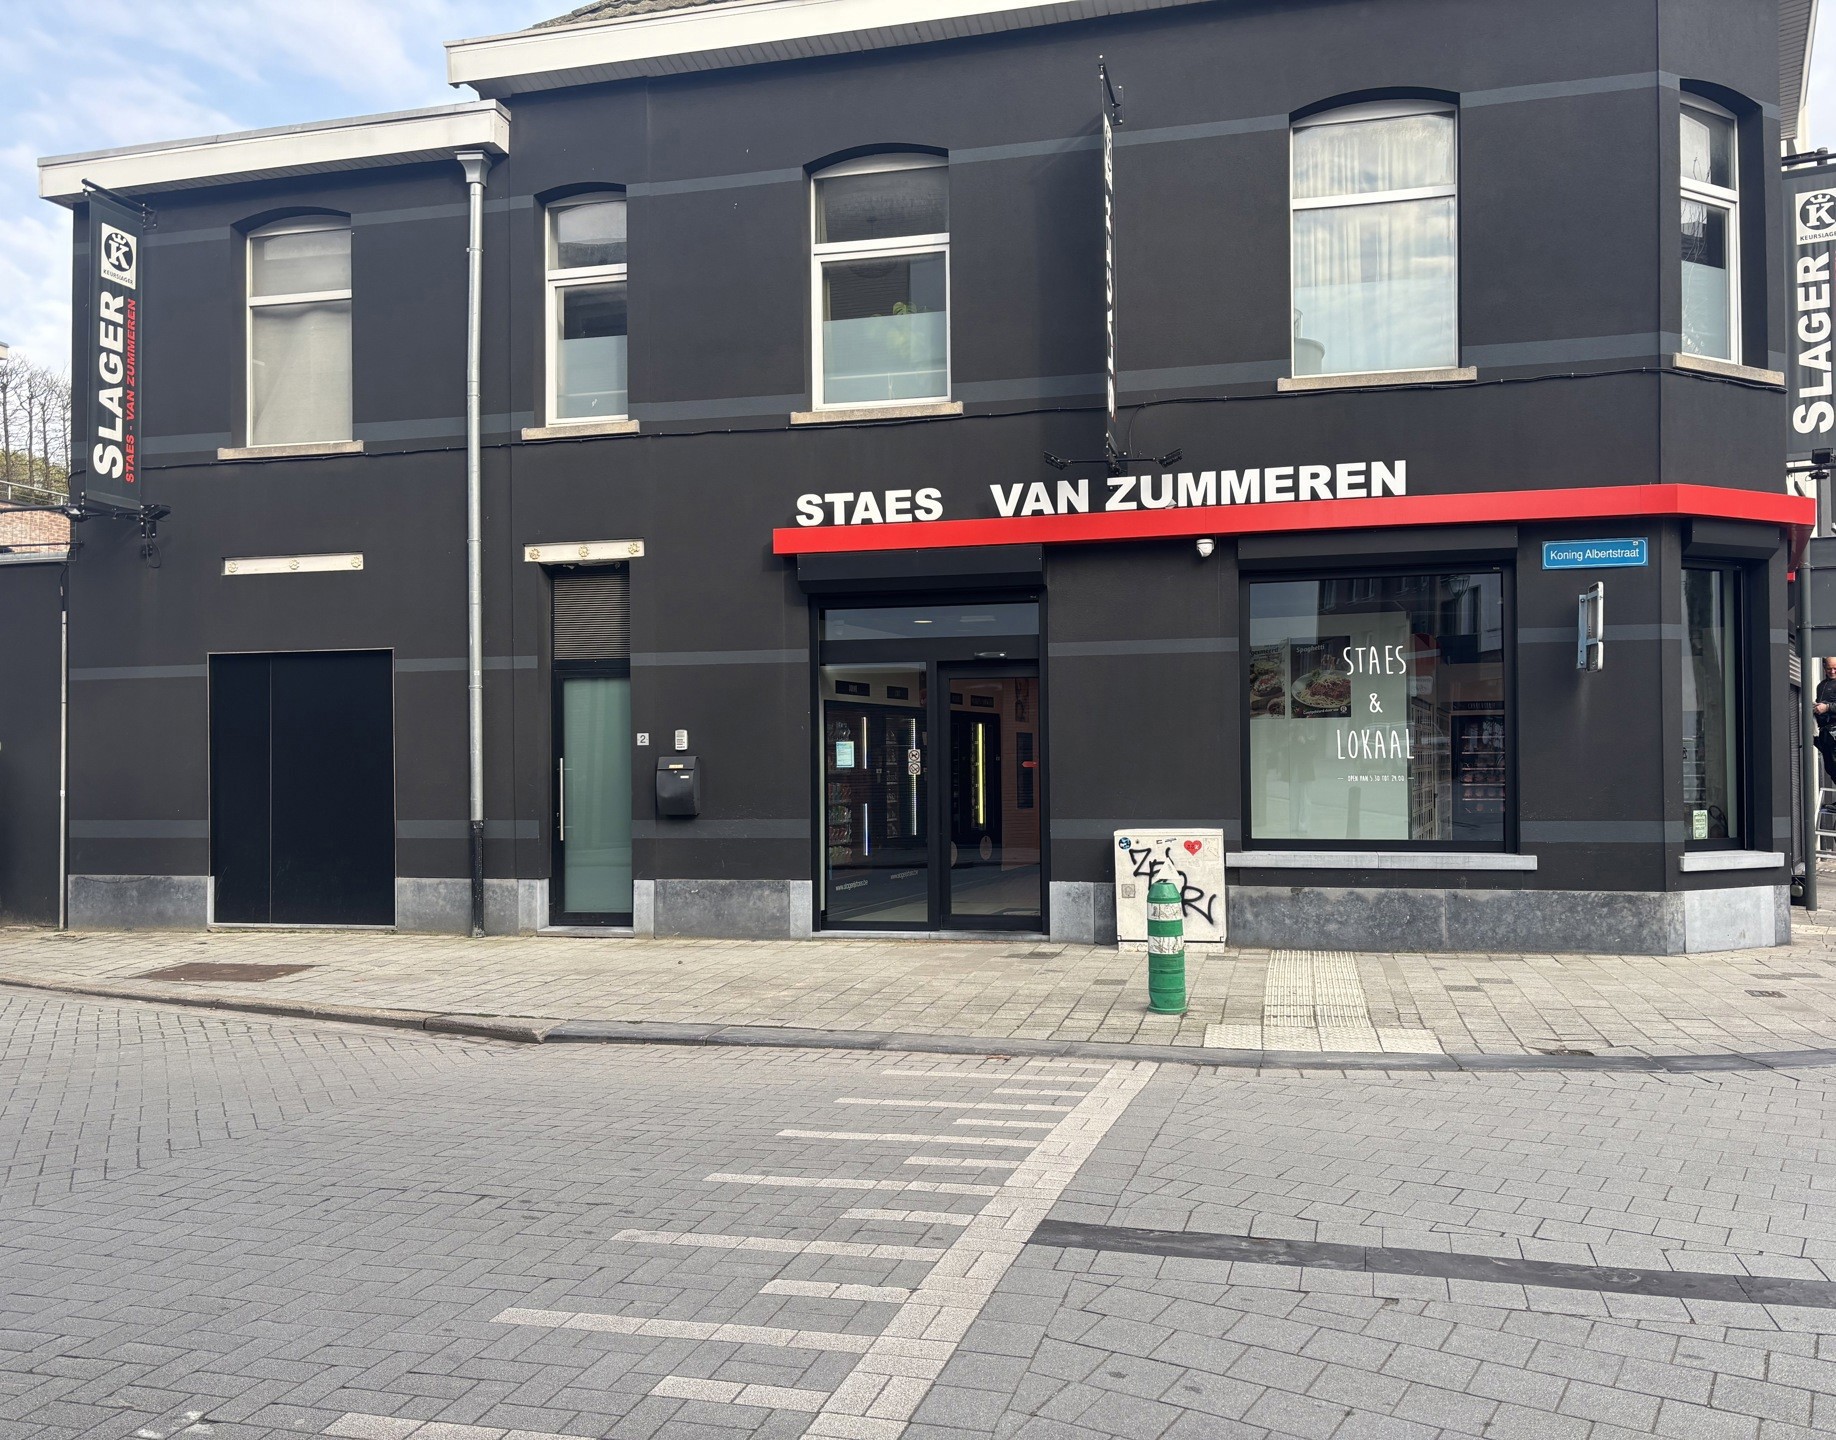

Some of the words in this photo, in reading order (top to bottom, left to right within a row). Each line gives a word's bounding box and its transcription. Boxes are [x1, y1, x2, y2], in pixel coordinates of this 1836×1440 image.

[103, 269, 134, 285] KEURSLAGER
[126, 298, 136, 386] ZUMMEREN
[1792, 252, 1834, 434] SLAGER
[94, 292, 124, 479] SLAGER
[126, 390, 135, 422] VAN
[126, 433, 134, 483] STAES
[796, 488, 943, 526] STAES
[990, 479, 1089, 517] VAN
[1106, 460, 1407, 512] ZUMMEREN
[1550, 550, 1583, 561] Koning
[1585, 549, 1639, 559] Albertstraat
[1296, 644, 1325, 654] Spaghetti
[1343, 645, 1406, 675] STAES
[1369, 692, 1383, 712] &
[640, 735, 646, 743] 2
[1336, 729, 1414, 760] LOKAAL
